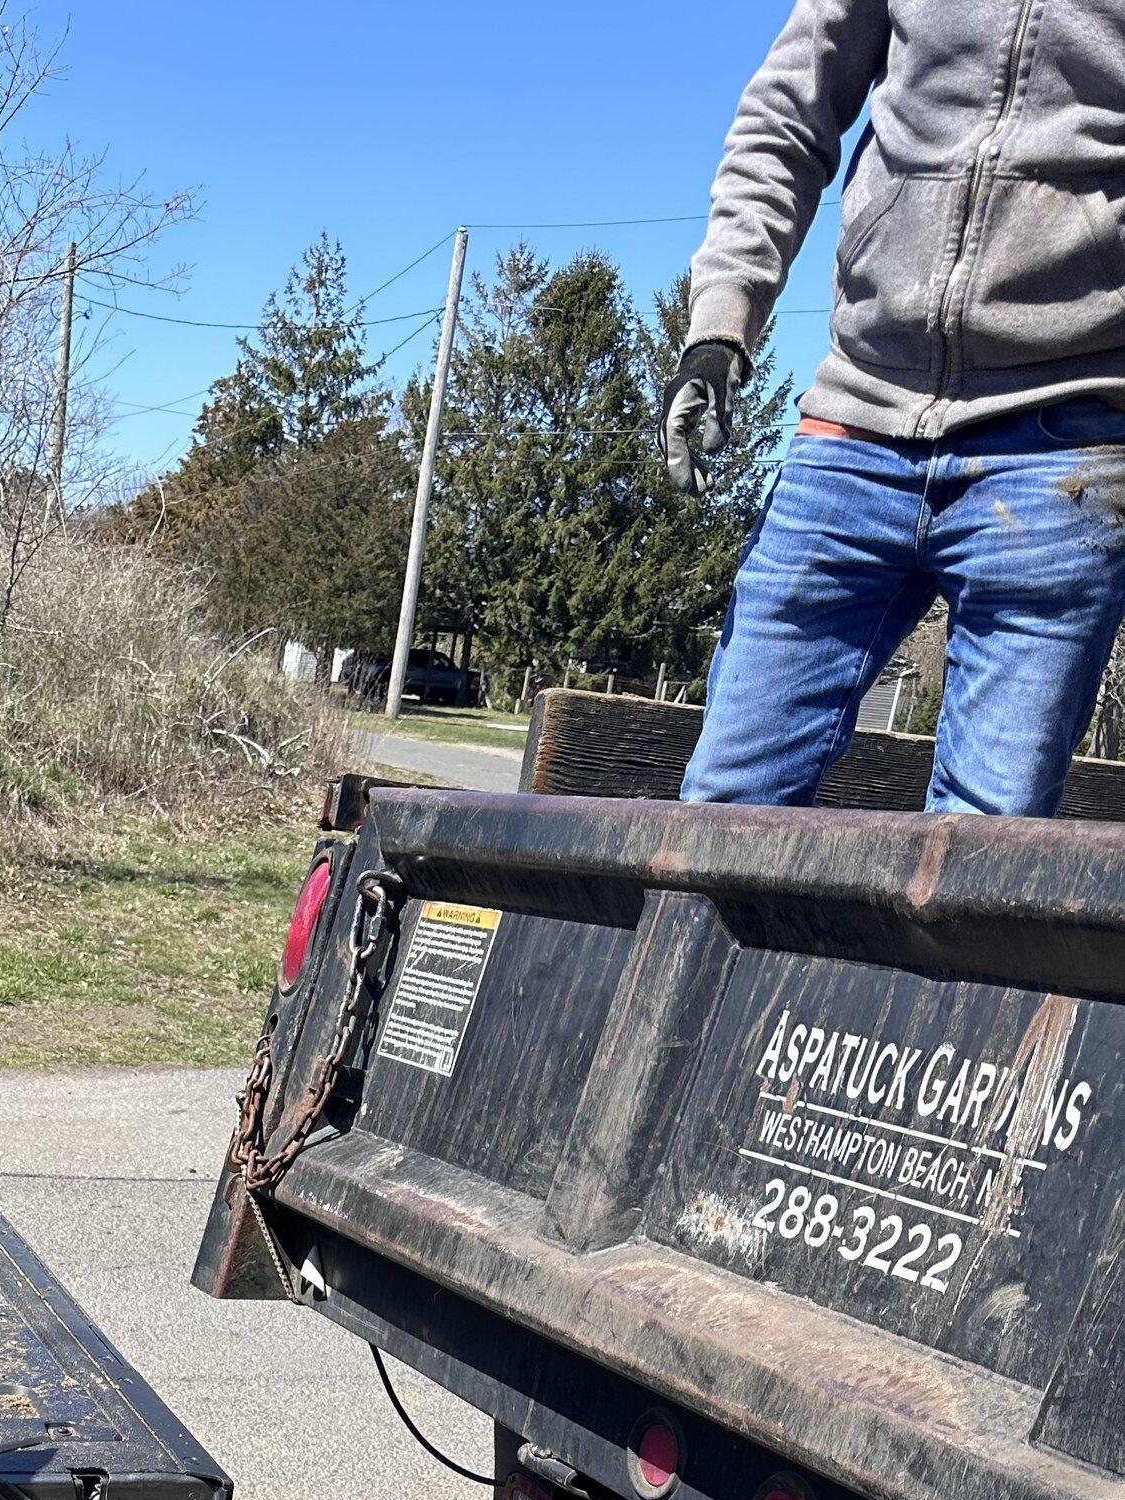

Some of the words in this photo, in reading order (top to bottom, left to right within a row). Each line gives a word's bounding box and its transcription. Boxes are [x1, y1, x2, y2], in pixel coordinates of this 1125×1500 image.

[442, 908, 475, 924] WARNING
[756, 1010, 922, 1110] ASPATUCK
[759, 1110, 899, 1179] WESTHAMPTON
[899, 1147, 970, 1208] BEACH,
[752, 1178, 963, 1294] 288-3222
